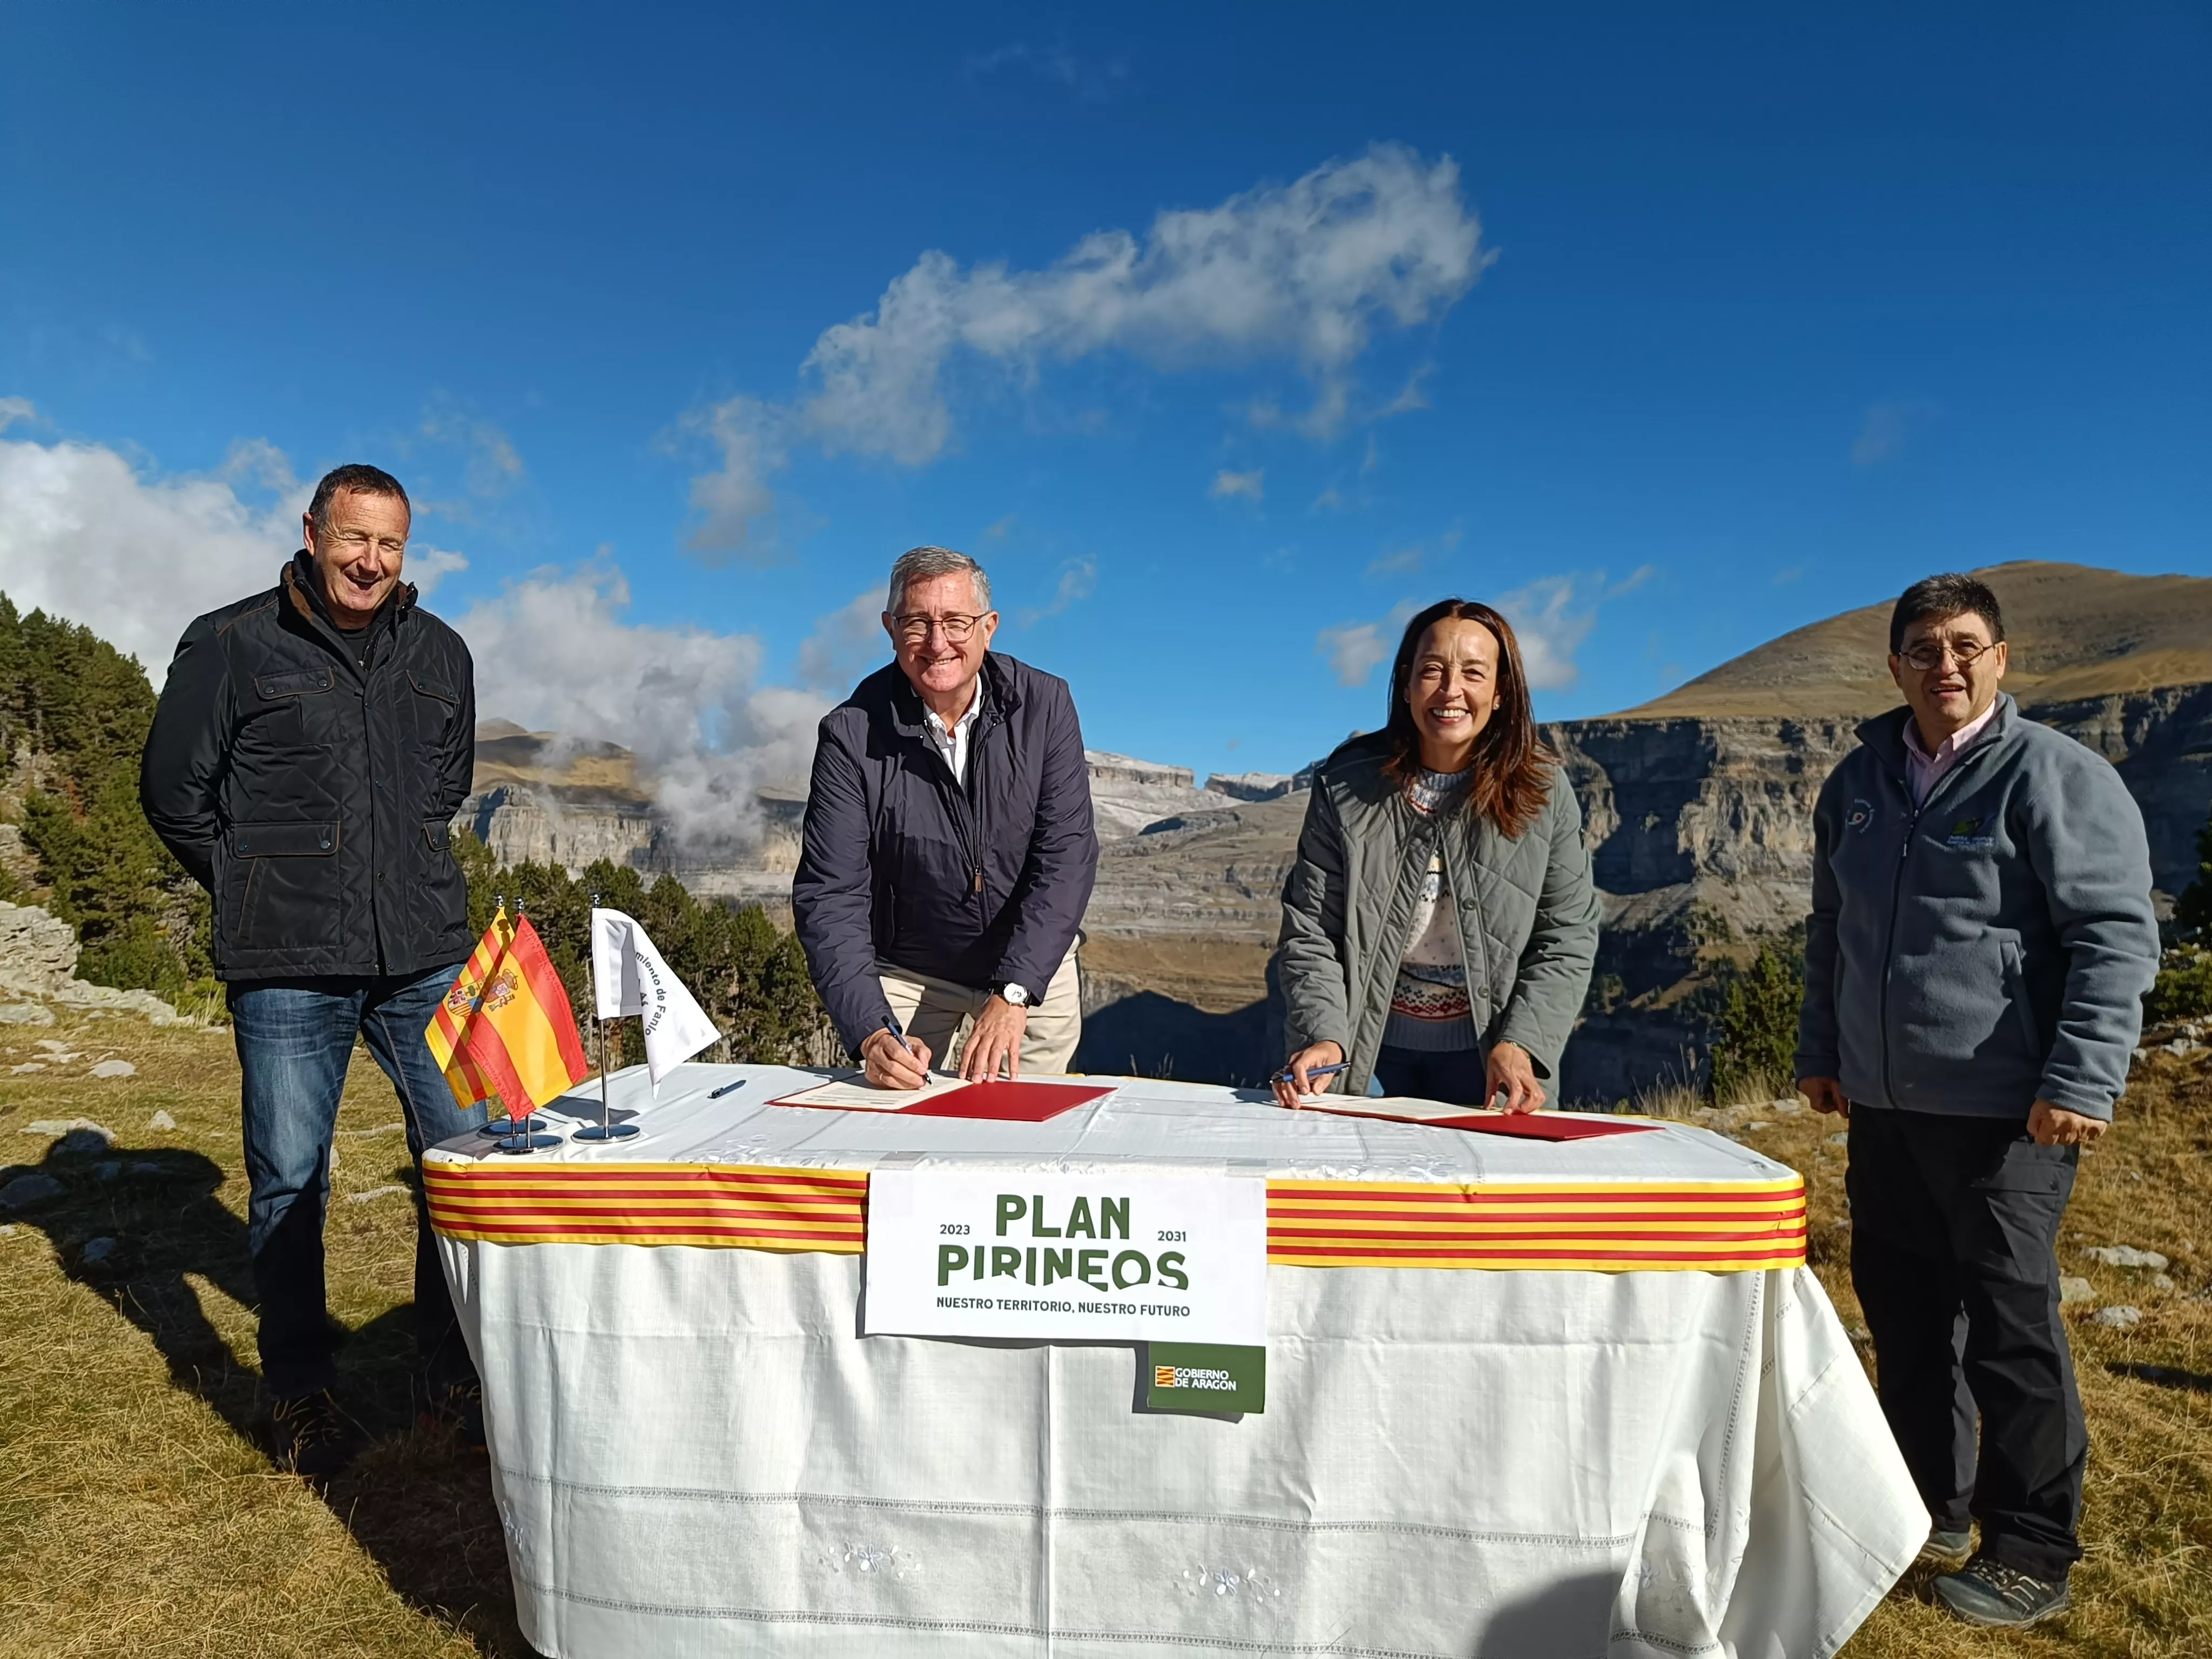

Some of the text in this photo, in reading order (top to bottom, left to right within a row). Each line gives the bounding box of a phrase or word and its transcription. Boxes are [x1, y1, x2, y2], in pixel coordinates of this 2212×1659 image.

[656, 988, 666, 1001] de
[645, 1005, 666, 1036] Fanlo
[995, 1193, 1130, 1240] PLAN
[940, 1224, 970, 1236] 2023
[1157, 1230, 1186, 1242] 2031
[938, 1244, 1189, 1292] PIRINEOS
[936, 1297, 1190, 1317] NUESTRO TERRITORIO, NUESTRO FUTURO
[1175, 1367, 1229, 1380] GOBIERNO
[1175, 1378, 1237, 1391] DE ARAGON
